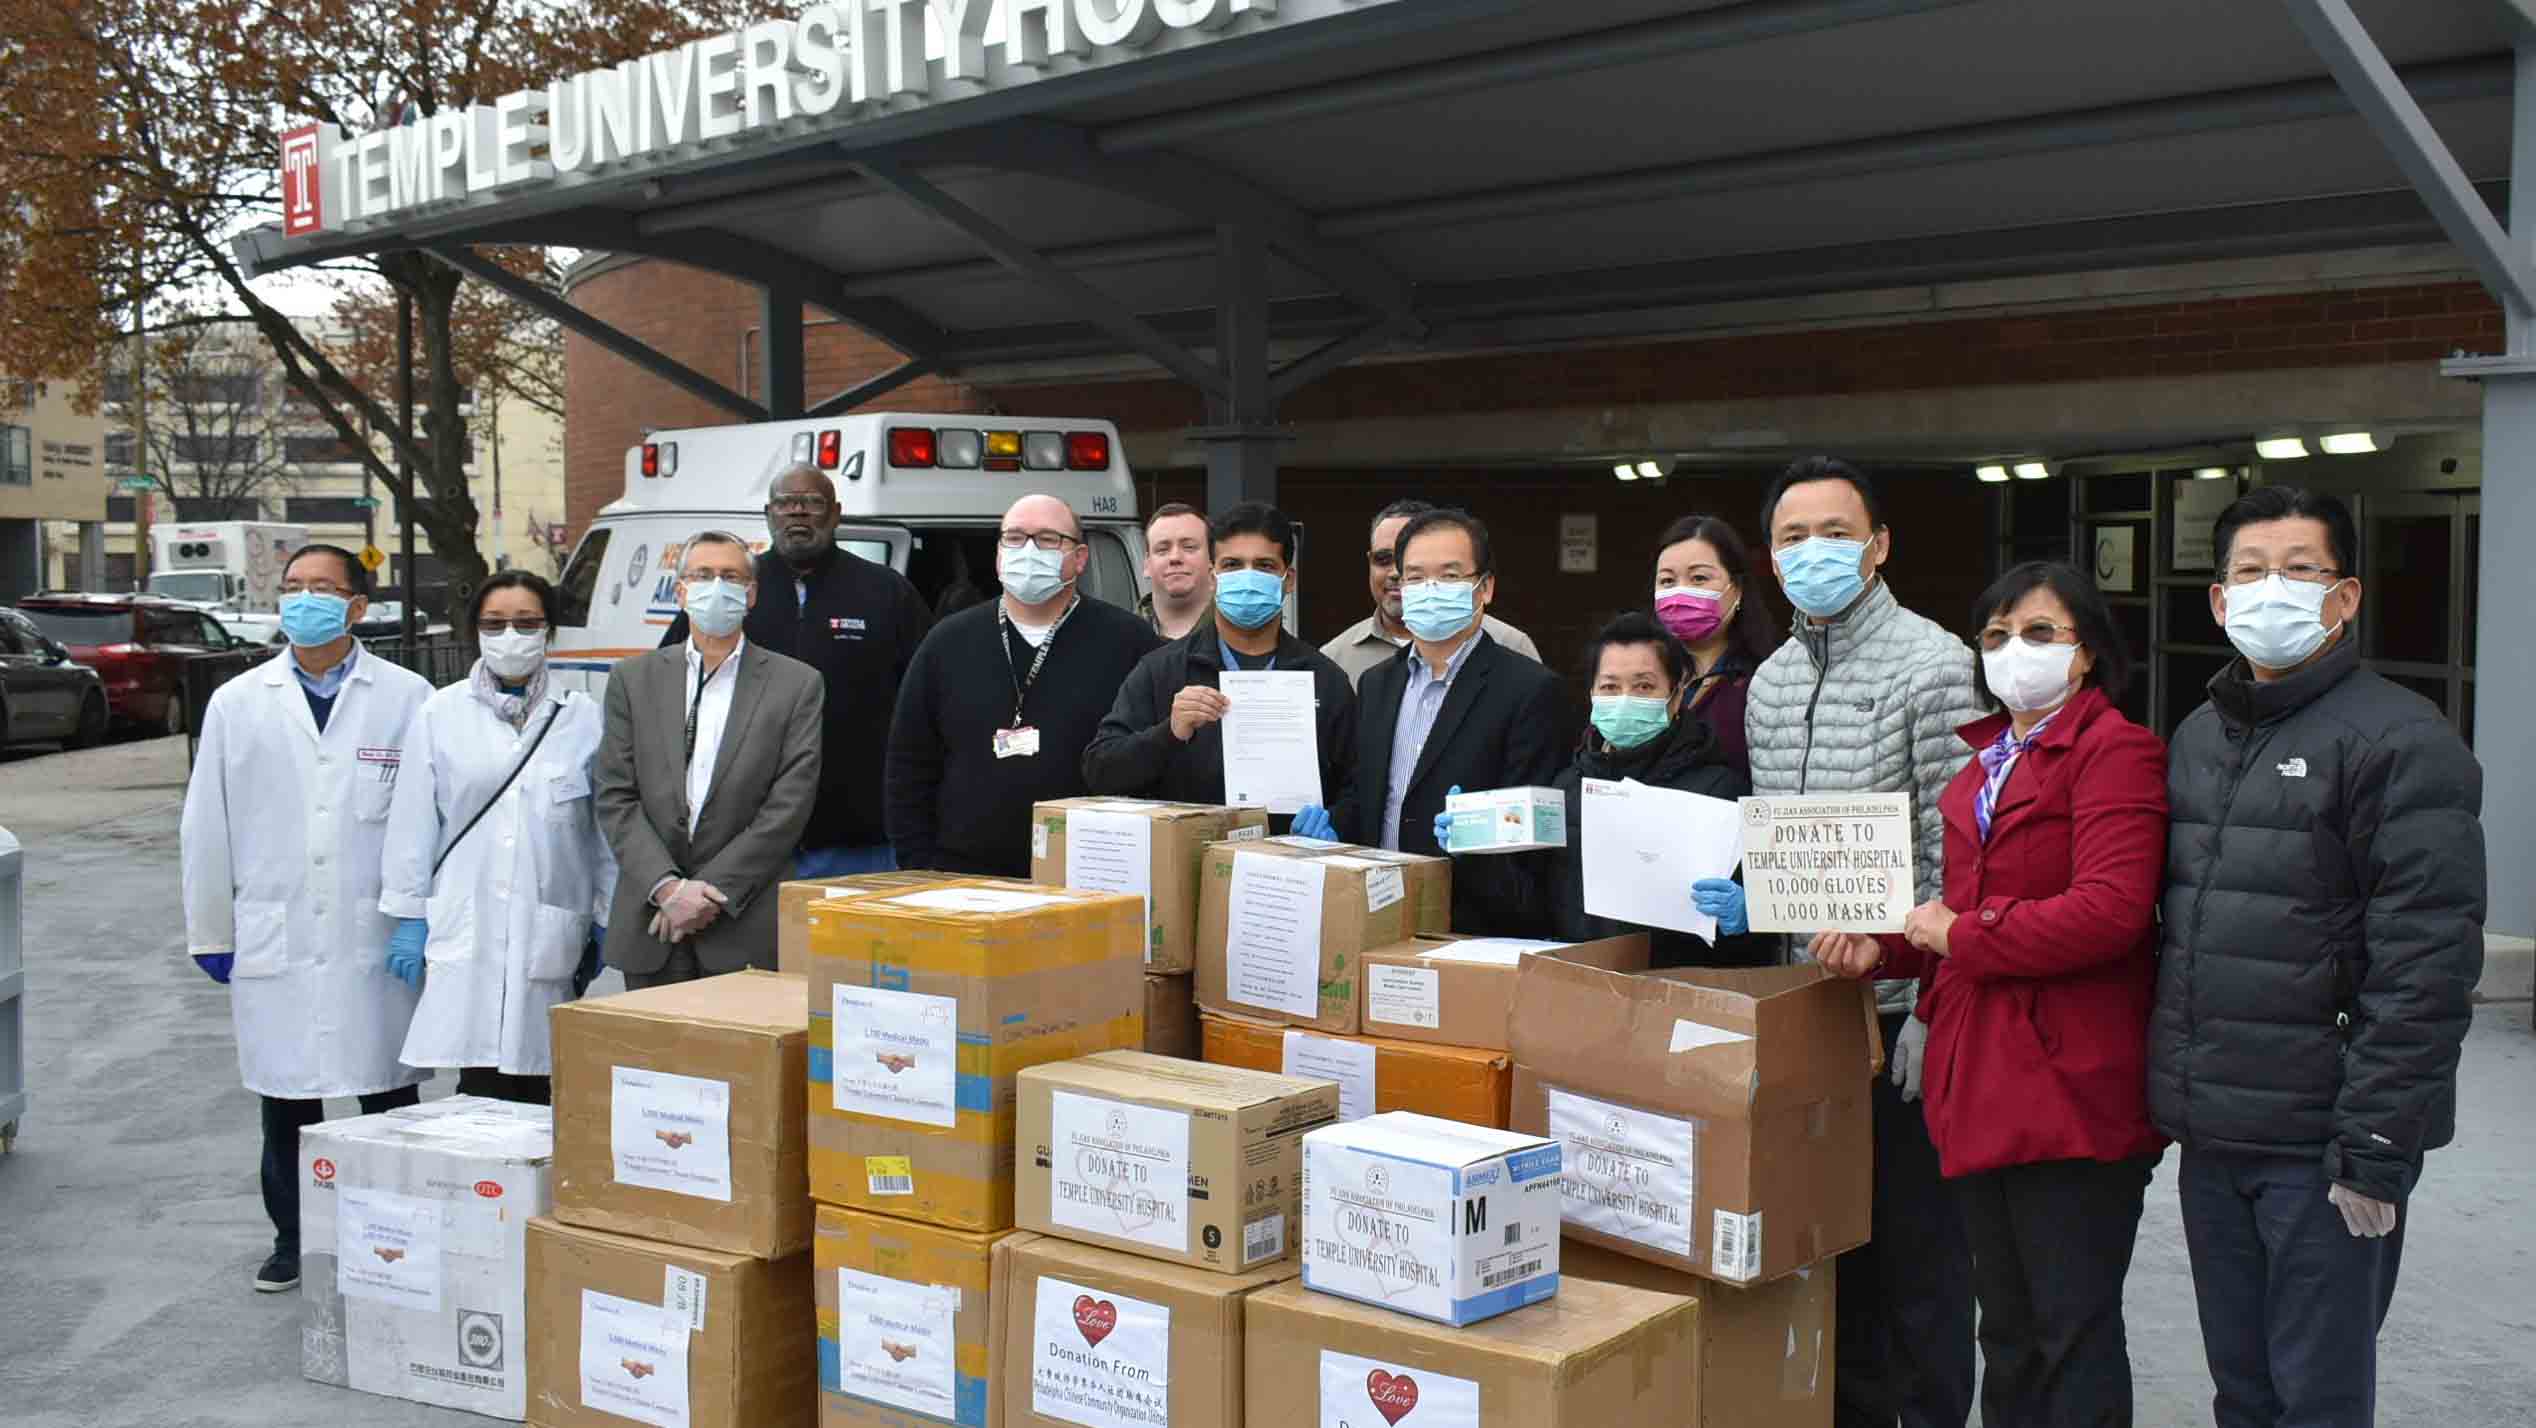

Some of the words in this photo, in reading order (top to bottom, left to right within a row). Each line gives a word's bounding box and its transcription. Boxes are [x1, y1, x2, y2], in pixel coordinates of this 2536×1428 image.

[332, 95, 529, 221] TEMPLE
[548, 0, 968, 171] UNIVERSITY
[1092, 496, 1117, 513] HA8
[1776, 823, 1844, 843] DONATE
[1853, 823, 1874, 842] TO
[1748, 851, 1788, 870] TEMPLE
[1790, 849, 1850, 870] UNIVERSITY
[1853, 849, 1905, 869] HOSPITAL
[1769, 878, 1819, 896] 10,000
[1825, 876, 1886, 895] GLOVES
[1771, 903, 1819, 921] 1,000
[1827, 902, 1887, 921] MASKS
[1088, 1154, 1130, 1180] DONATE
[1133, 1163, 1147, 1183] TO
[1587, 1152, 1632, 1182] DONATE
[1635, 1166, 1649, 1186] TO
[1059, 1180, 1089, 1203] TEMPLE
[1090, 1186, 1136, 1215] UNIVERSITY
[1136, 1198, 1176, 1222] HOSPITAL
[1465, 1195, 1487, 1236] M
[1560, 1181, 1586, 1201] EMPLE
[1588, 1184, 1637, 1215] UNIVERSITY
[1638, 1197, 1680, 1225] HOSPITAL
[1208, 1230, 1216, 1242] S
[1347, 1211, 1391, 1240] DONATE
[1395, 1223, 1409, 1244] TO
[1315, 1238, 1346, 1265] TEMPLE
[1348, 1247, 1398, 1278] UNIVERSITY
[1399, 1259, 1440, 1288] HOSPITAL
[1078, 1310, 1113, 1330] Love
[1050, 1342, 1108, 1370] Donation
[1113, 1360, 1150, 1382] From
[1064, 1387, 1084, 1406] Chinese
[1084, 1392, 1113, 1417] Community
[1113, 1399, 1147, 1421] Organization
[1374, 1382, 1414, 1407] Love
